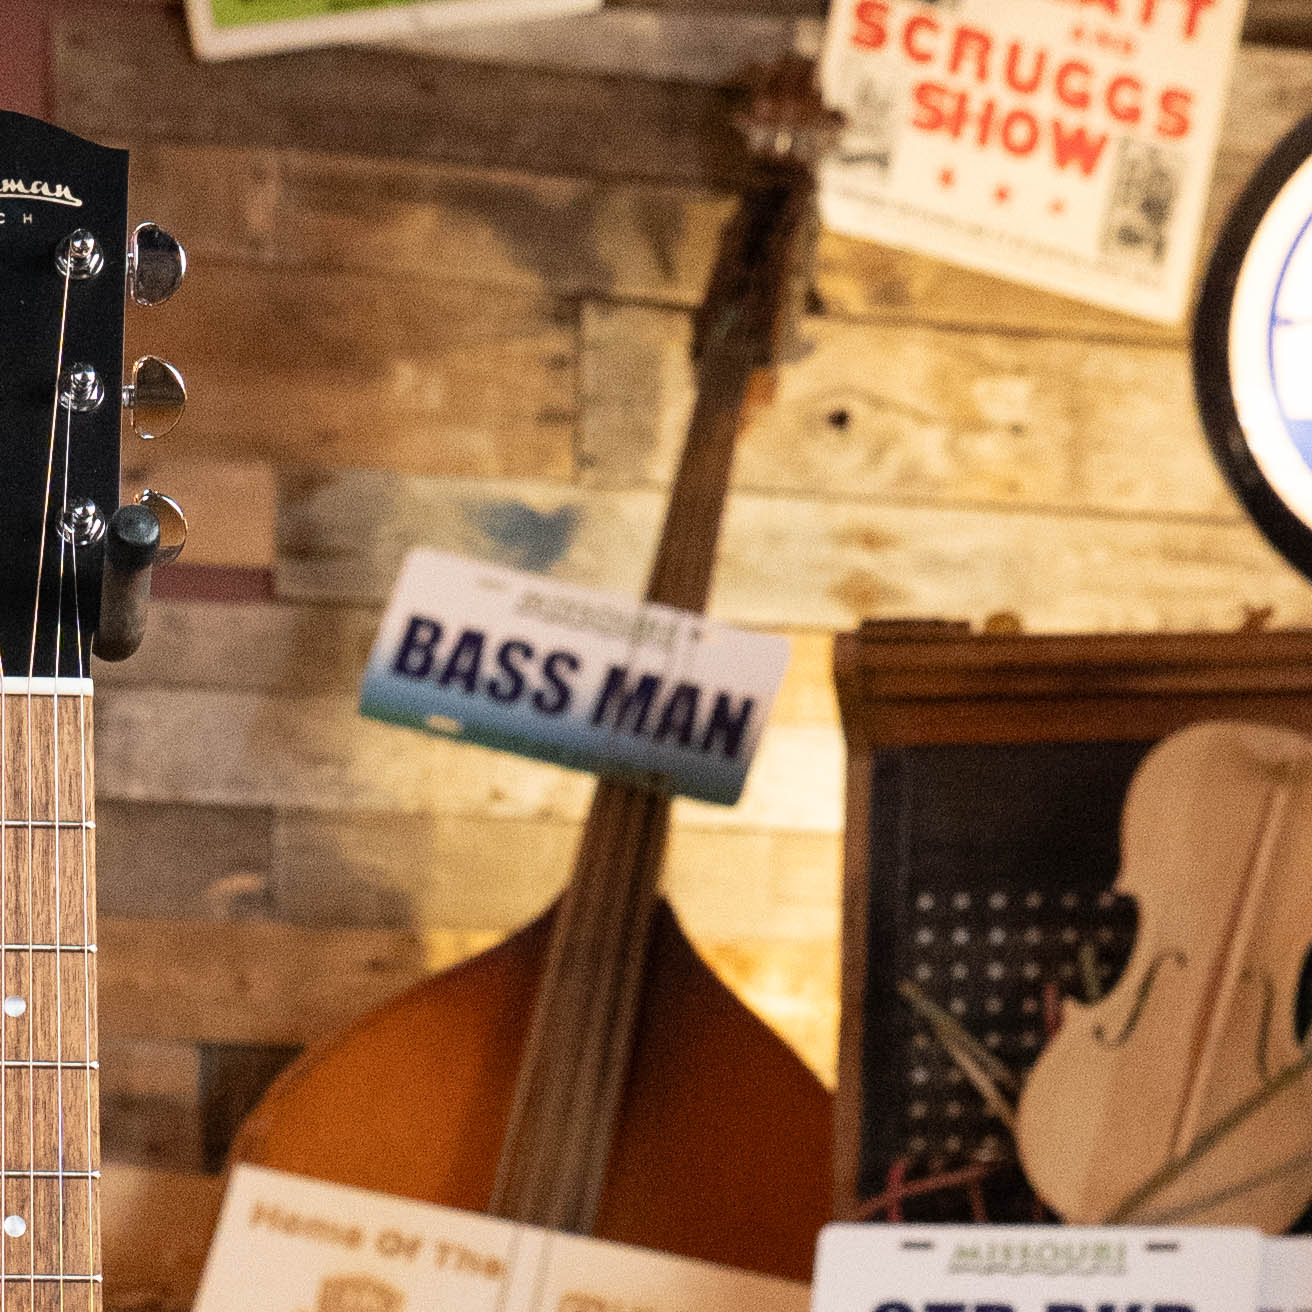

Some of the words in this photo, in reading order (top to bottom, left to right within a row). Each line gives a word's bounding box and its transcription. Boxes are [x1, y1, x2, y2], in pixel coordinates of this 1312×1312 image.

[851, 0, 1193, 138] SCRUGGS
[911, 82, 1107, 177] SHOW
[394, 615, 580, 717] BASS
[591, 664, 754, 758] MAN
